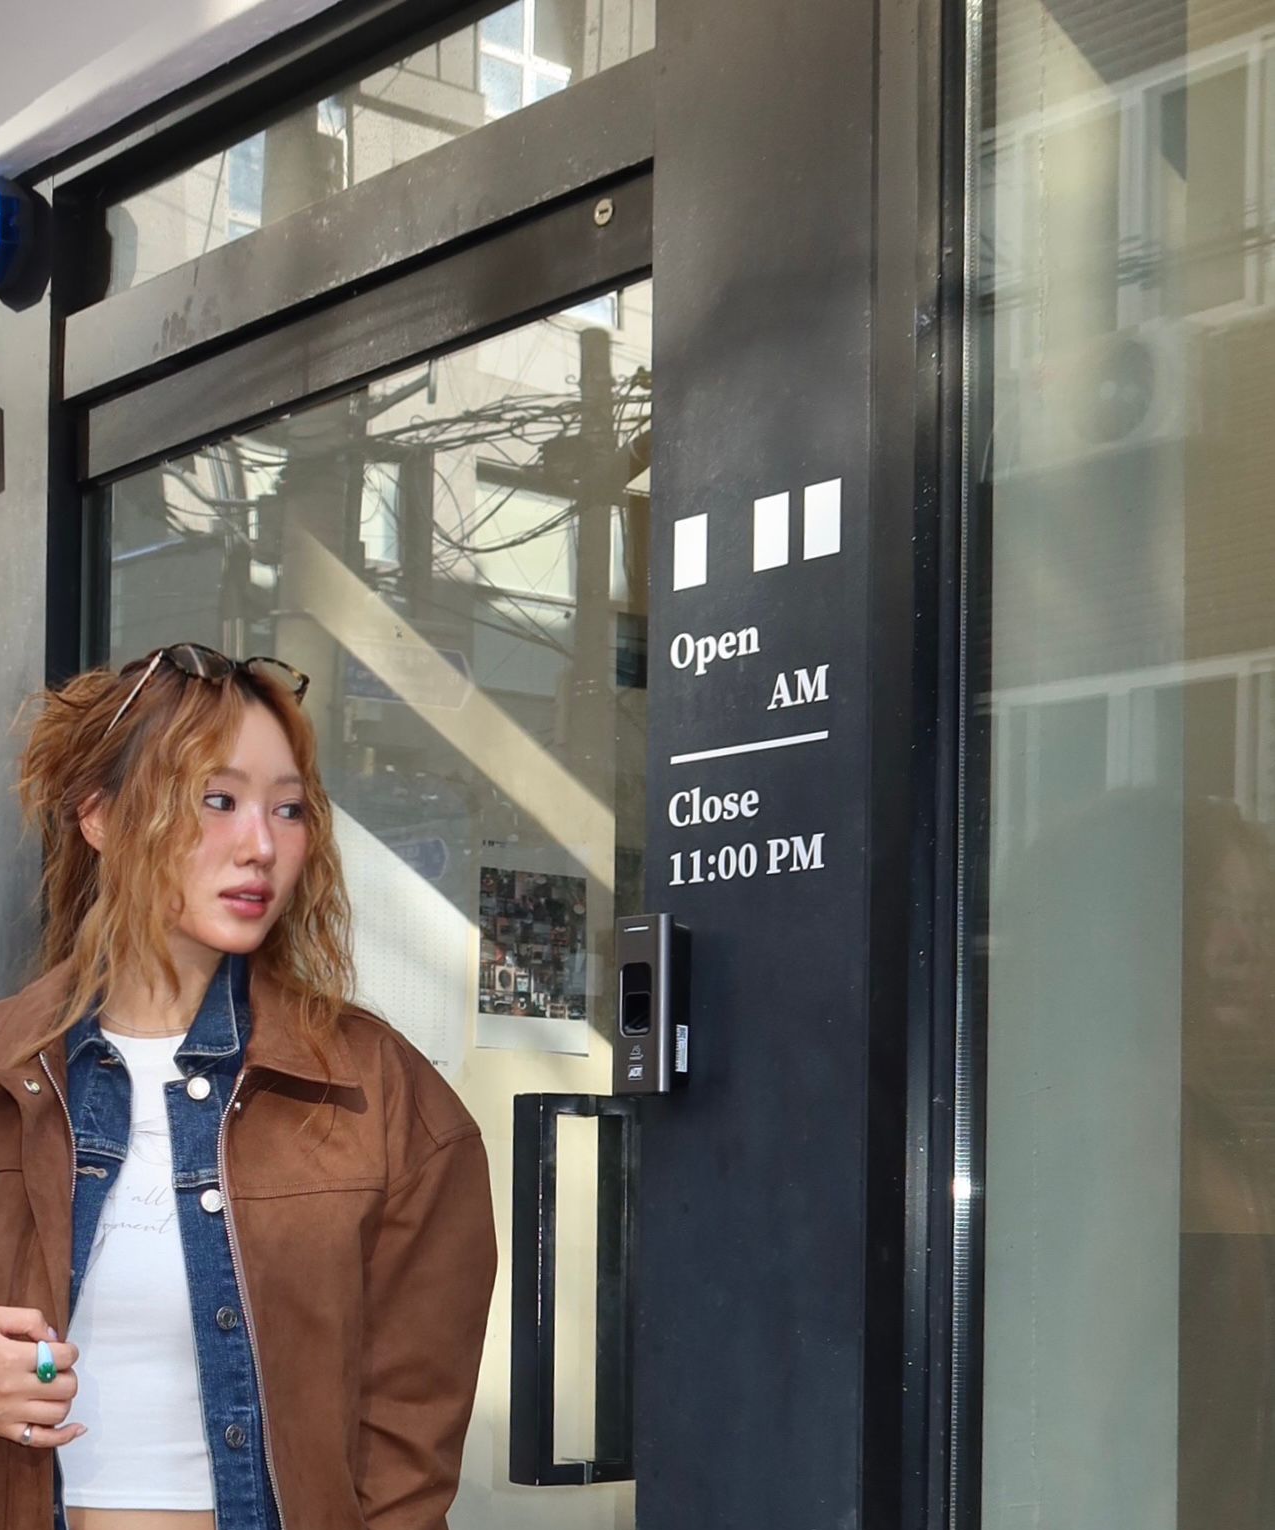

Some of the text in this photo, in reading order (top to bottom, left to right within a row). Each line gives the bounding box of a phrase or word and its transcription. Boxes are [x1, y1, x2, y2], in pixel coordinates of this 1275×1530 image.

[670, 626, 761, 676] Open
[766, 663, 830, 710] AM
[668, 786, 760, 828] Close
[668, 832, 826, 886] 11:00 PM
